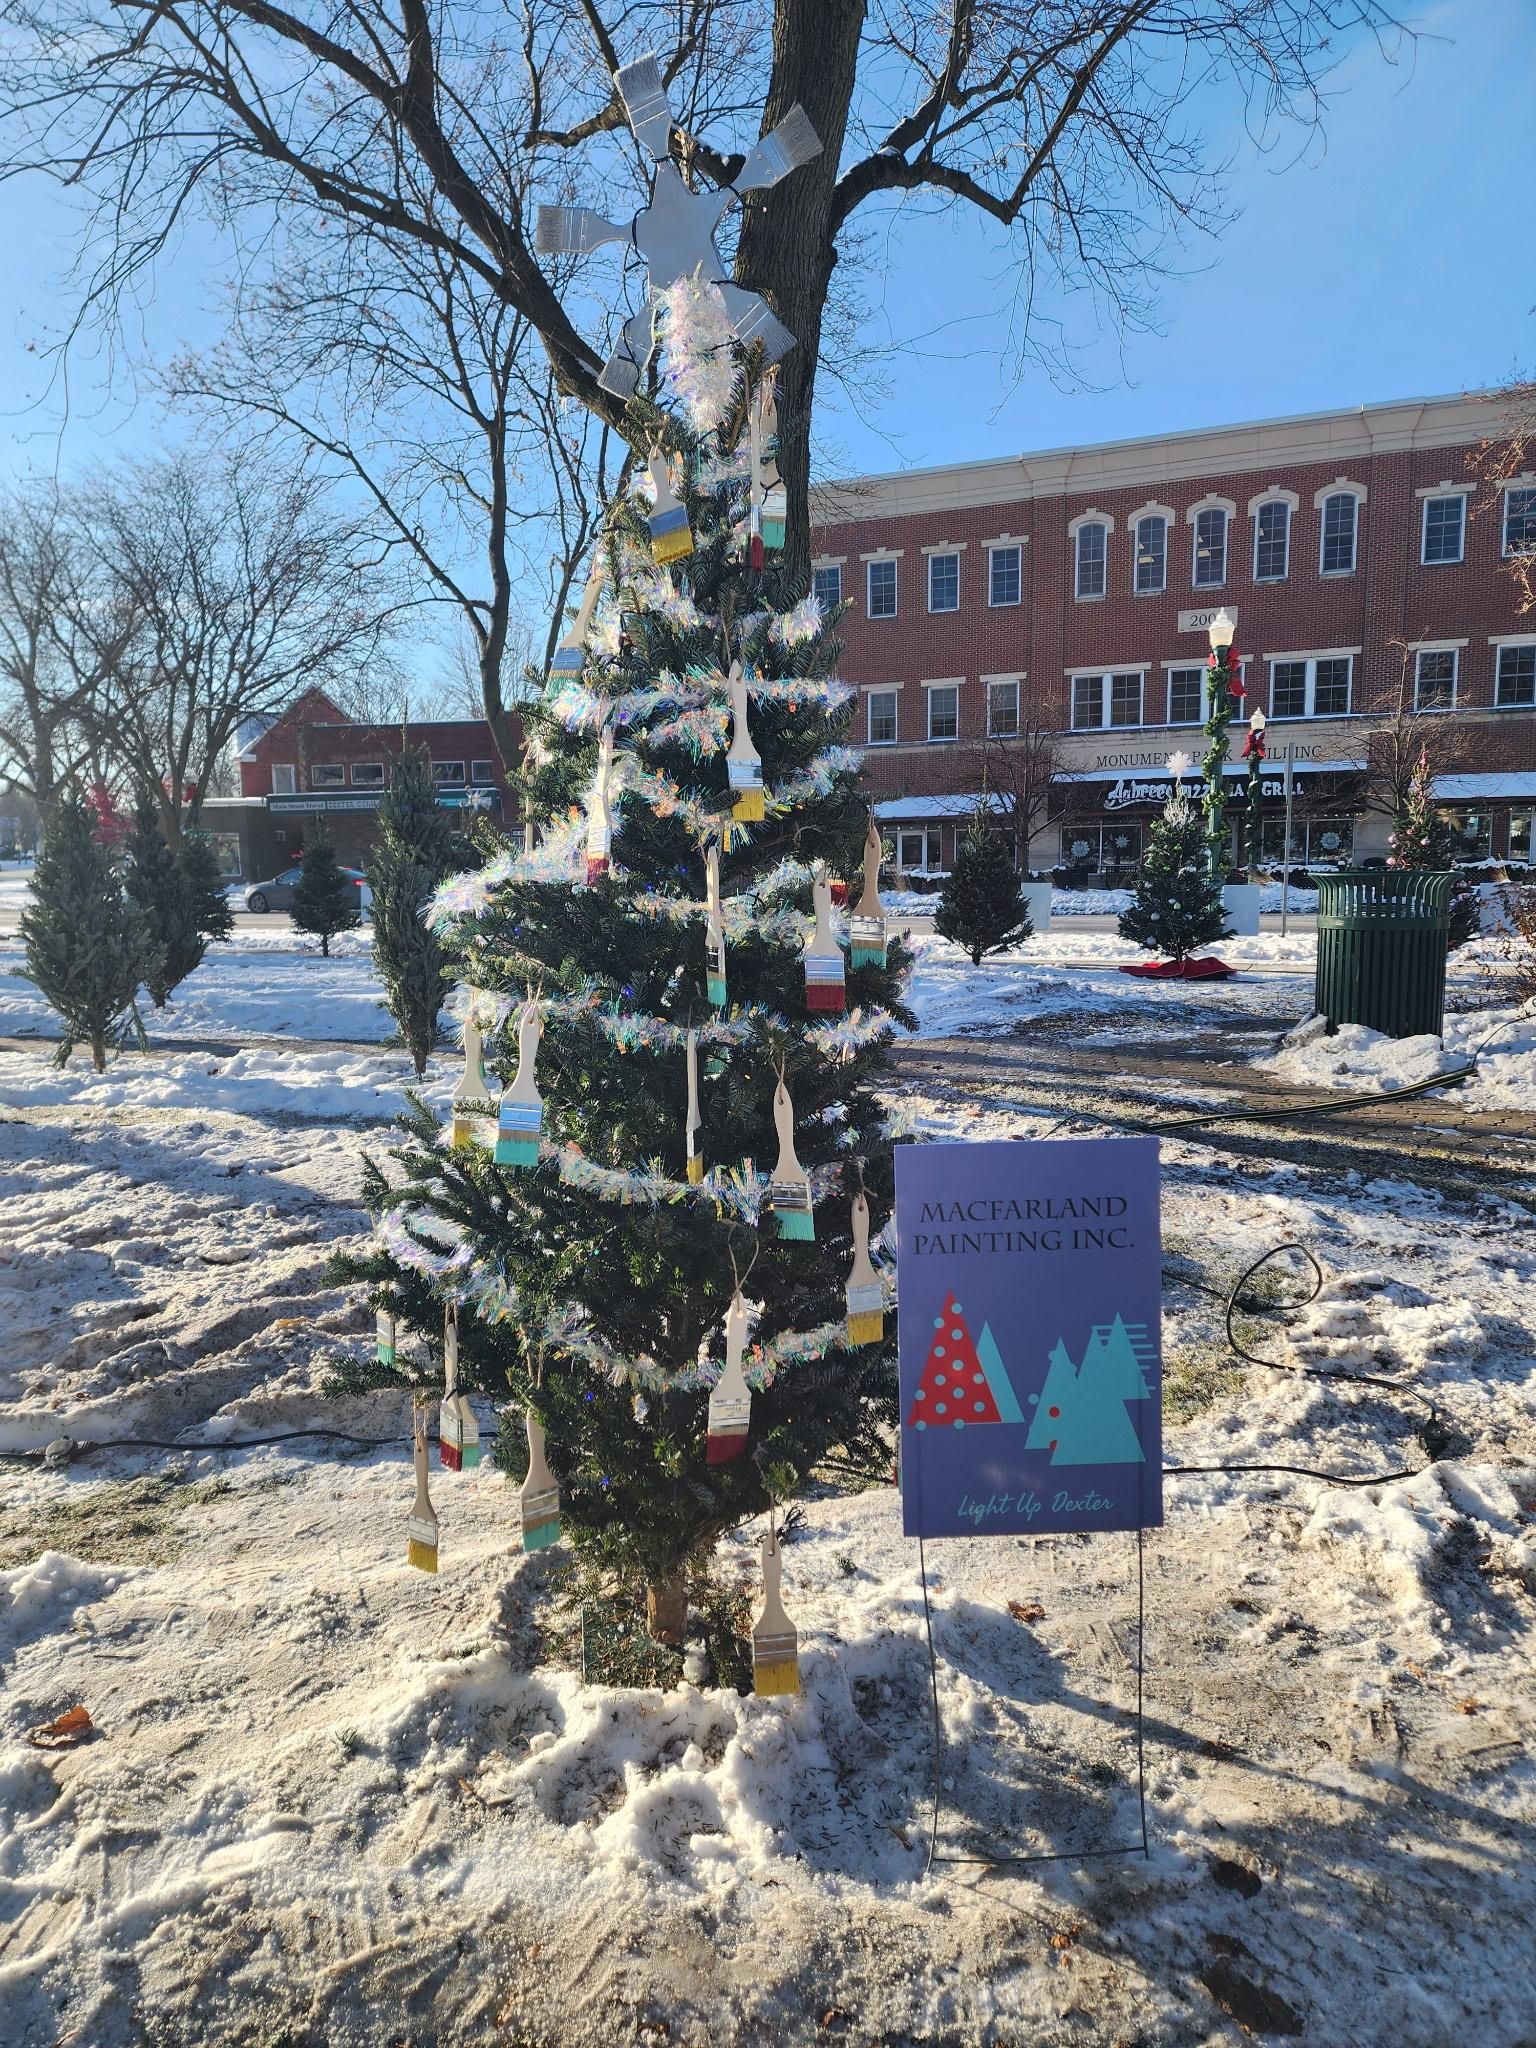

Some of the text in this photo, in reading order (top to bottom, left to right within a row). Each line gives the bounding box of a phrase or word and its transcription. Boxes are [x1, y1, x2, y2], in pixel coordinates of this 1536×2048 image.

[1190, 613, 1221, 627] 200
[1097, 752, 1175, 768] MONUMEN
[920, 1196, 1127, 1223] MACFARLAND
[914, 1228, 1136, 1255] PAINTING INC.
[957, 1490, 1114, 1526] Light Up Dexter
